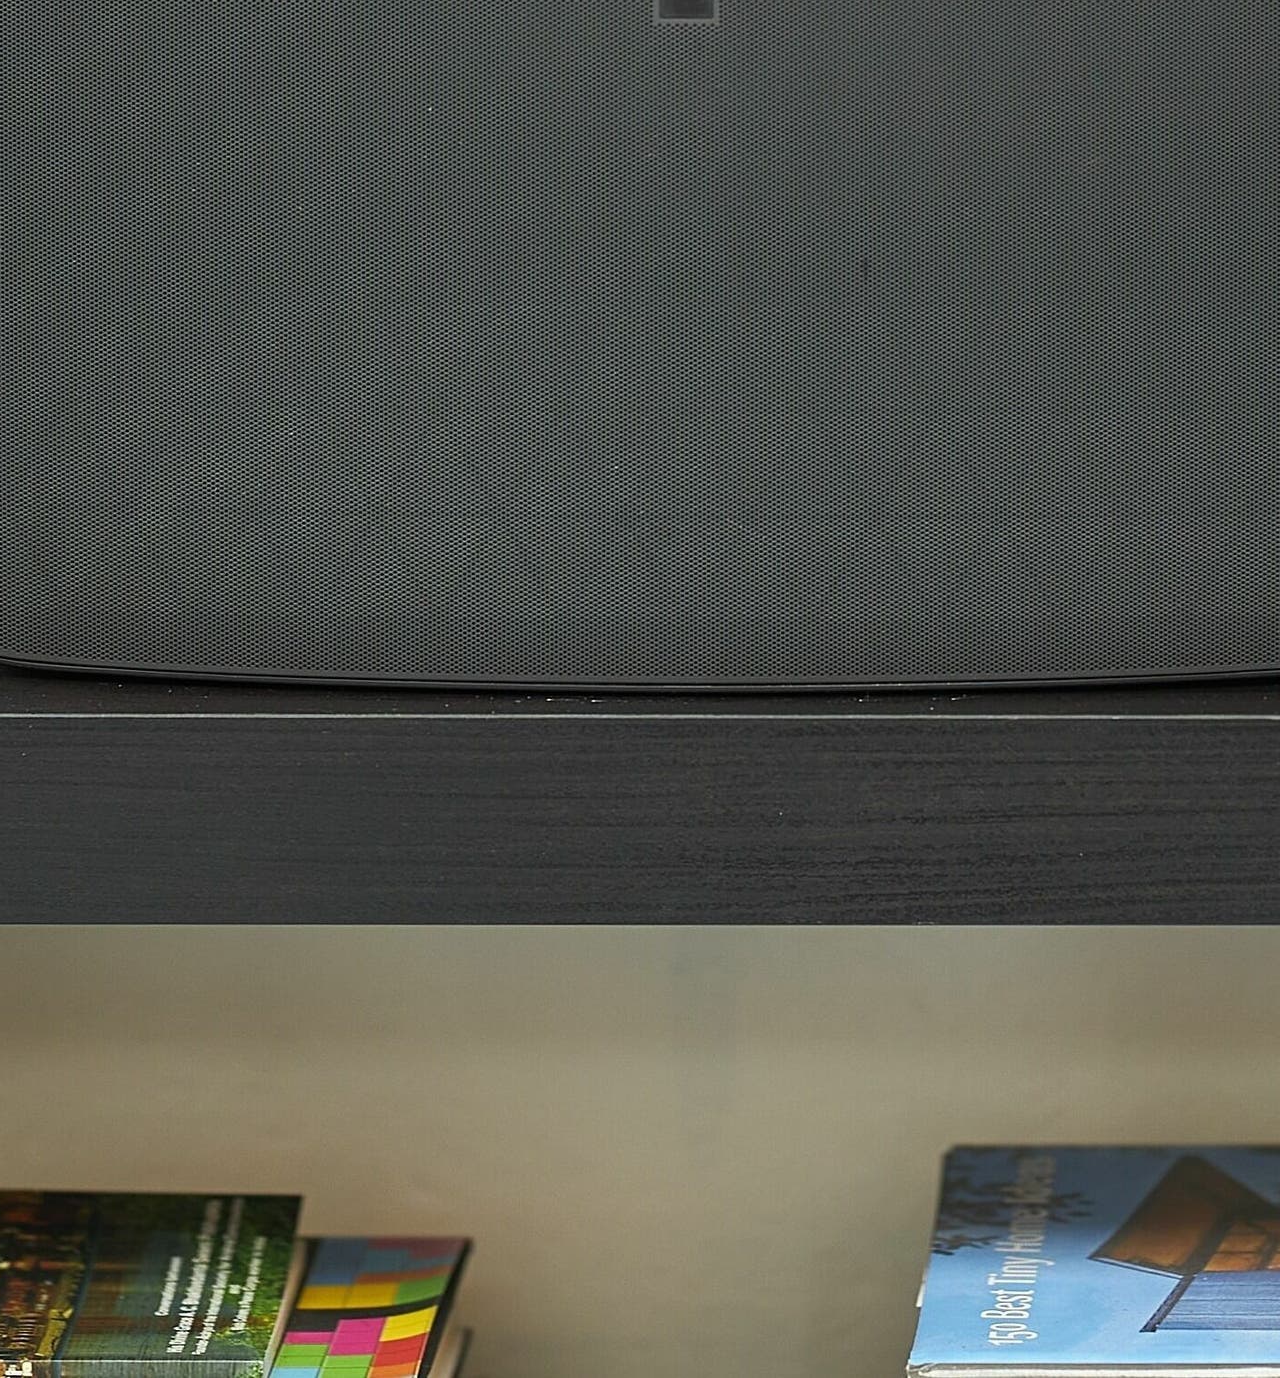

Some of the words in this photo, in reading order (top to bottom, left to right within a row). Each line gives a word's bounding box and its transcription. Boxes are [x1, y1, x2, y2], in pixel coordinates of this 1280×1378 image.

[993, 1206, 1048, 1253] Home
[987, 1255, 1055, 1286] Tiny
[980, 1289, 1035, 1319] Best
[987, 1322, 1038, 1346] 150
